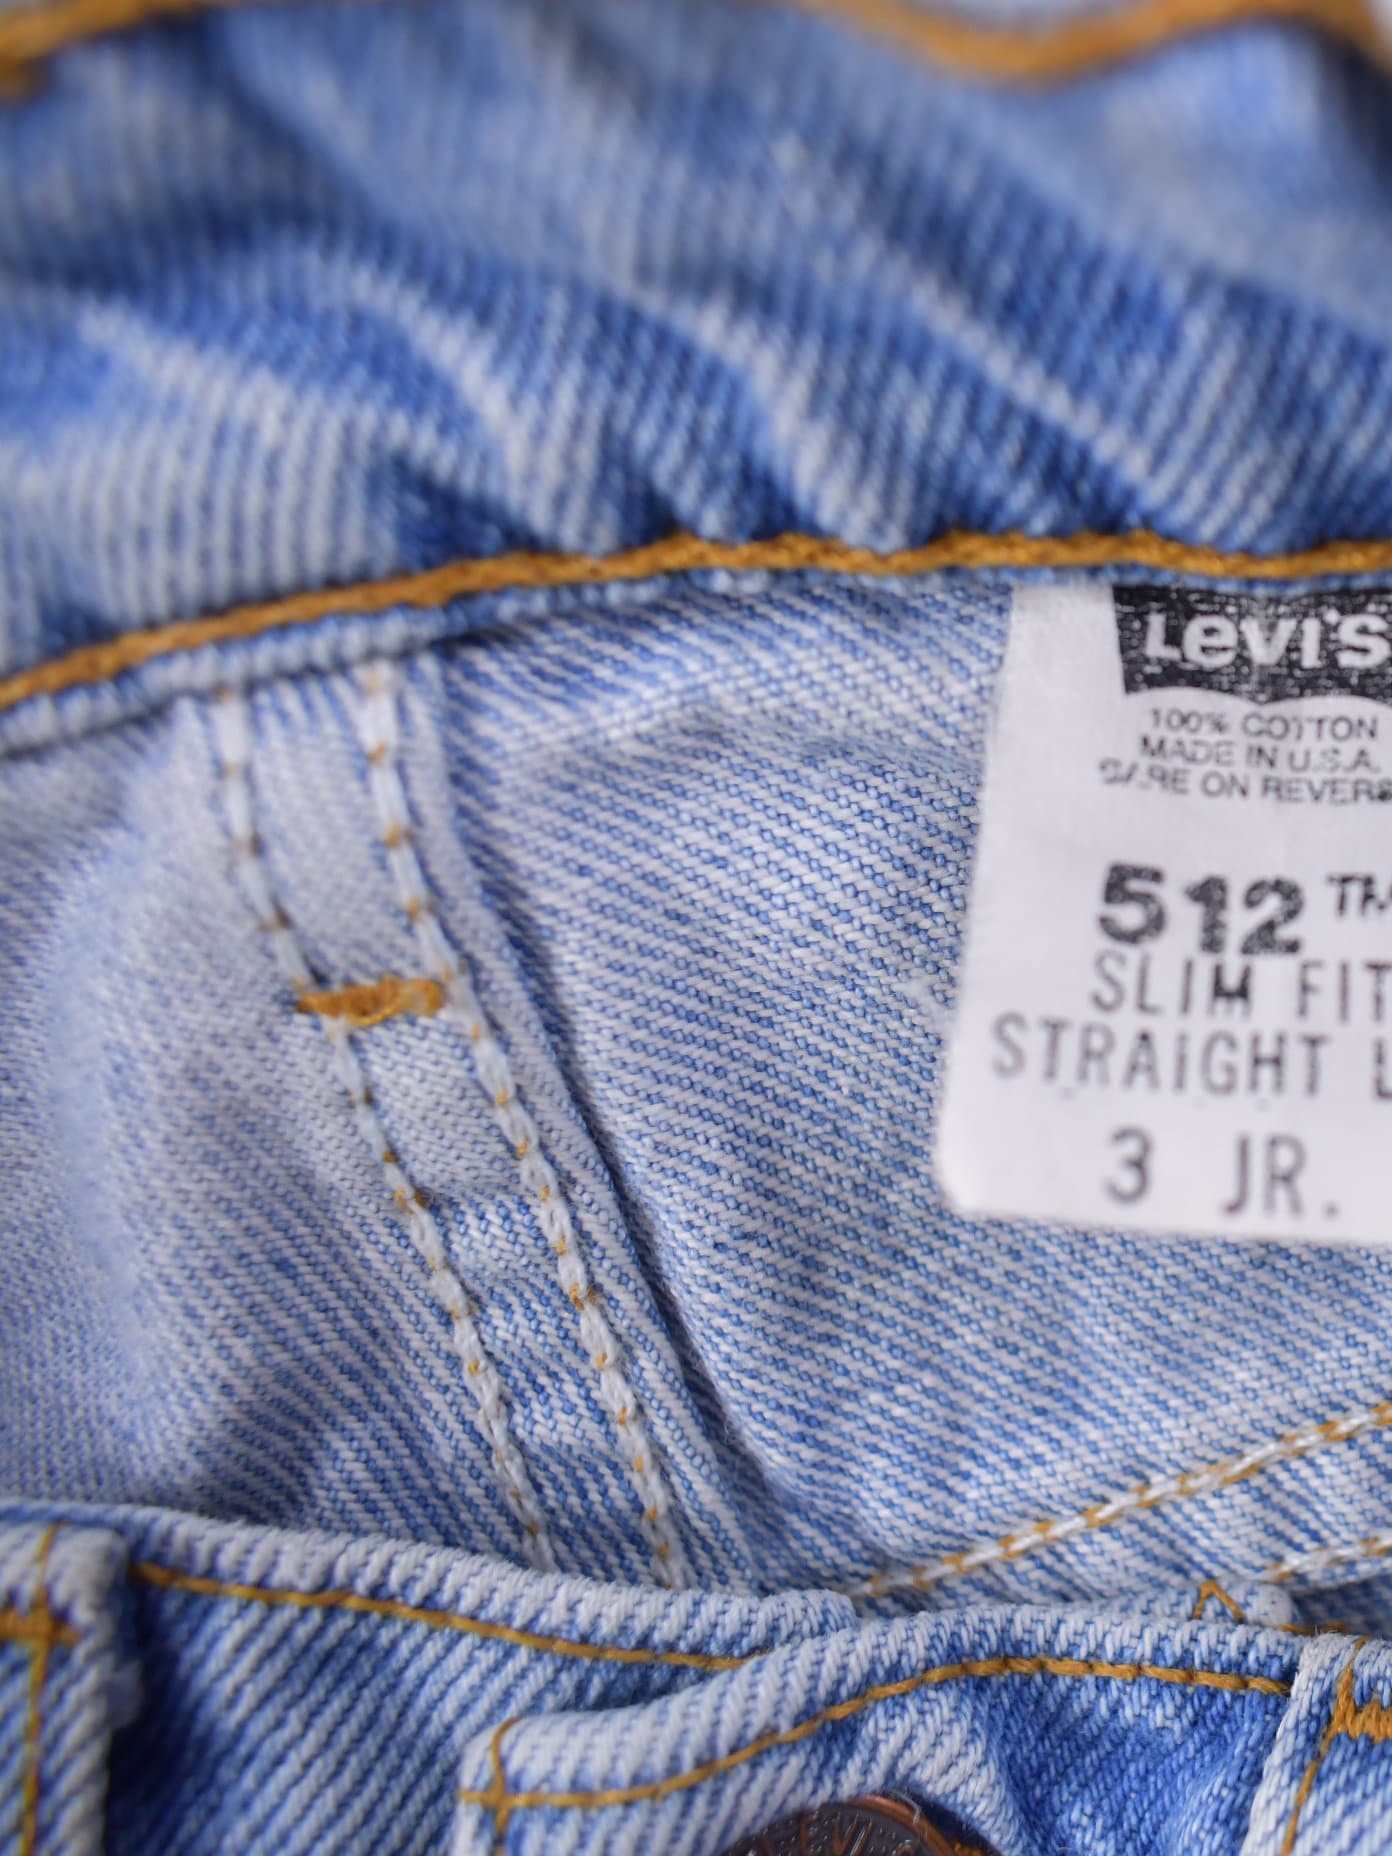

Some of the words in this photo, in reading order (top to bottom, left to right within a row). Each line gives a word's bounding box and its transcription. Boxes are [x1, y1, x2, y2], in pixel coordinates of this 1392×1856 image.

[1140, 735, 1235, 768] MADE
[1246, 745, 1278, 769] IN
[1288, 748, 1381, 774] U.S.A.
[1151, 707, 1230, 735] 100%
[1241, 711, 1379, 741] COTTON
[1200, 770, 1251, 798] ON
[1099, 863, 1305, 956] 512
[1091, 949, 1253, 1019] SLIM
[992, 1012, 1331, 1100] STRAIGHT
[1105, 1126, 1154, 1204] 3
[1222, 1131, 1339, 1220] JR.
